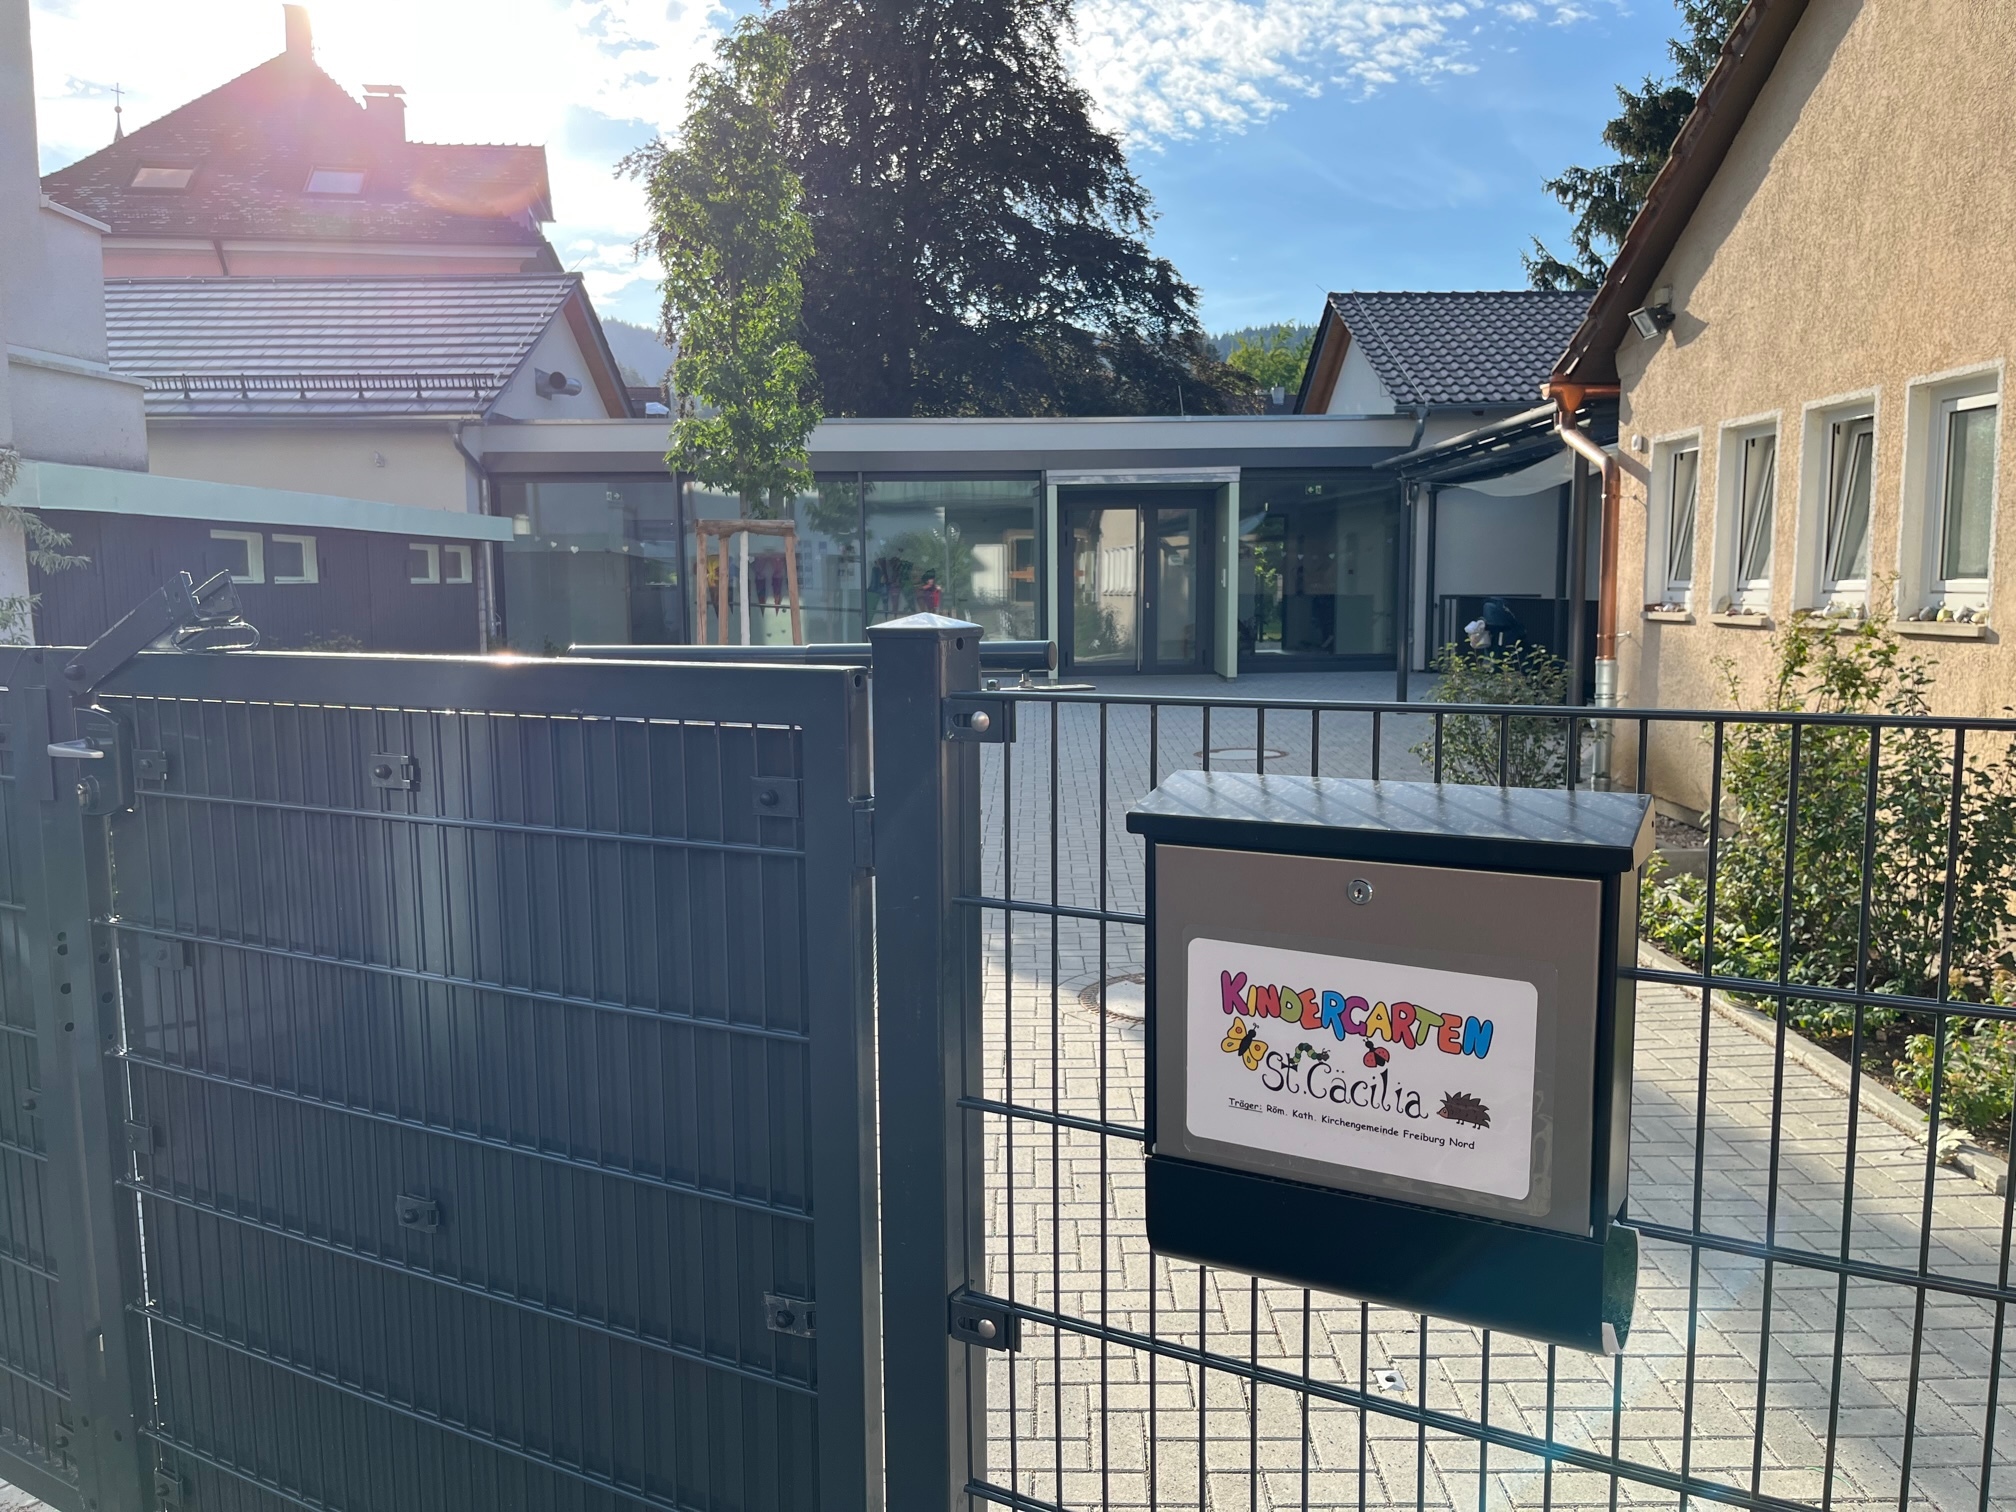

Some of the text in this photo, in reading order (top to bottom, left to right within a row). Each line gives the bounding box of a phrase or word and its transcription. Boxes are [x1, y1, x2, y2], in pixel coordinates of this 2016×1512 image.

[1220, 970, 1494, 1059] KINDERGARTEN
[1228, 1097, 1475, 1150] Träger: Röm. Kath. Kirchengemeinde Freiburg Nord
